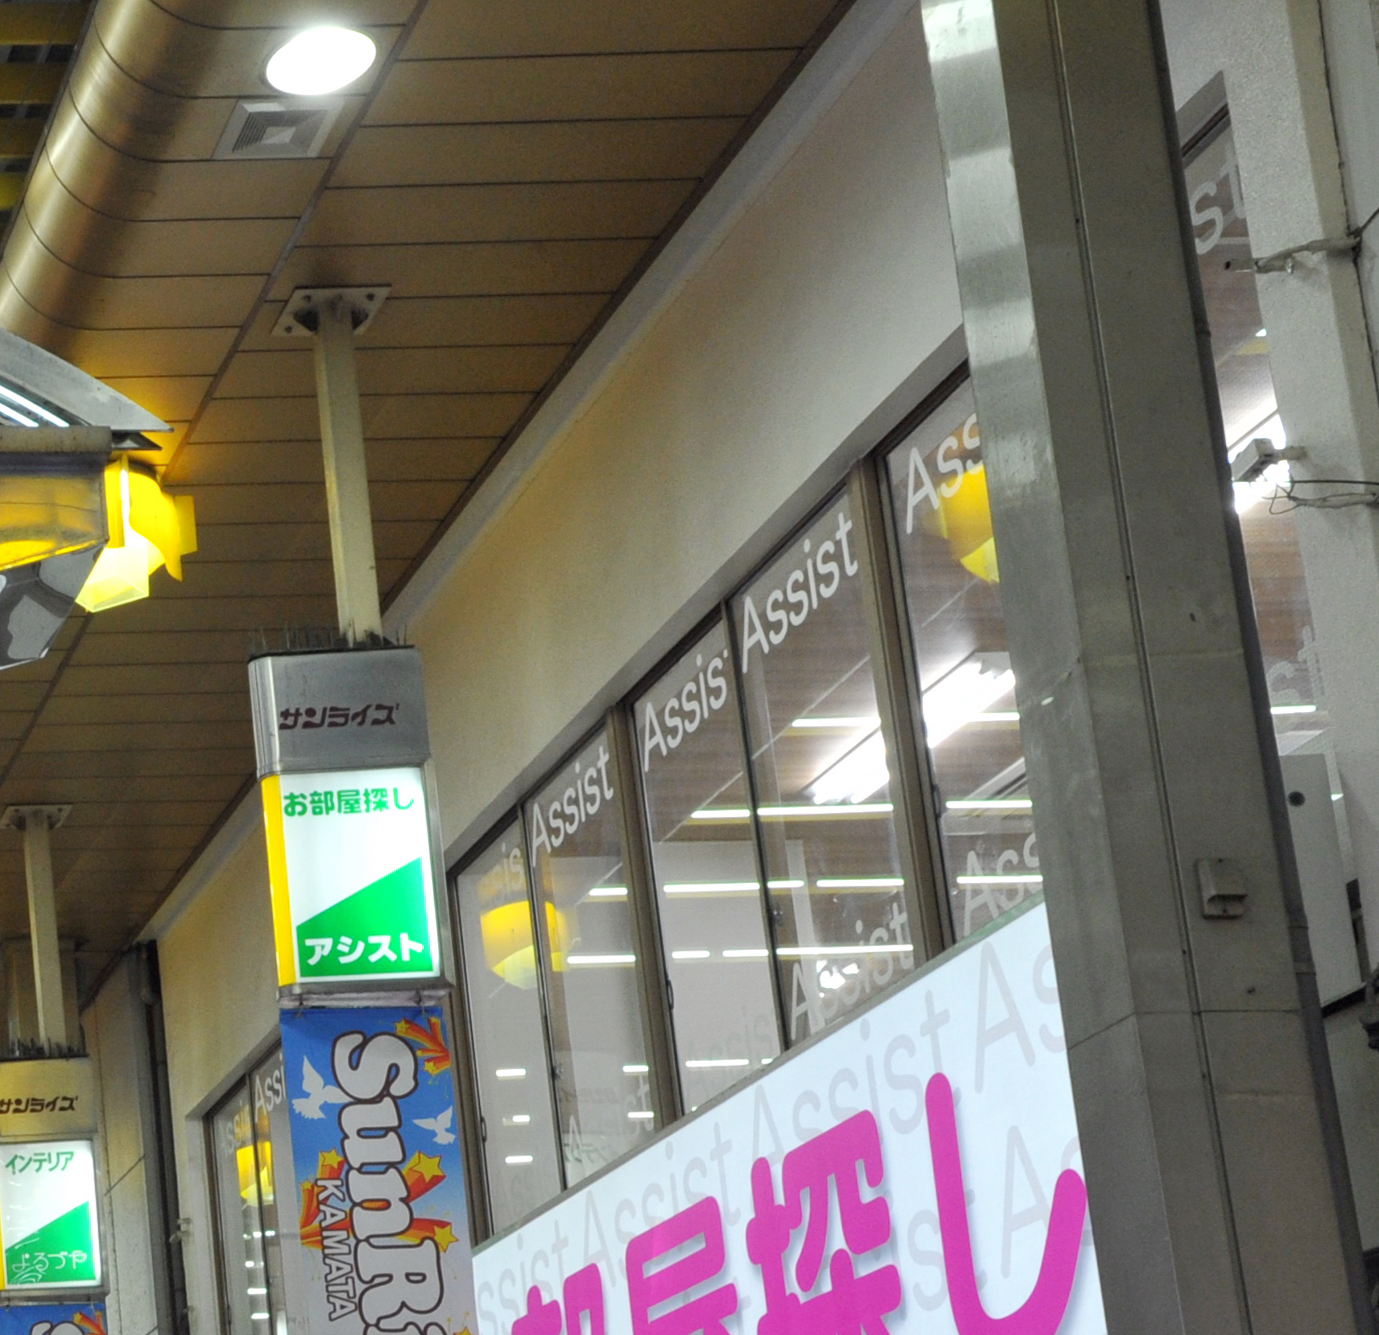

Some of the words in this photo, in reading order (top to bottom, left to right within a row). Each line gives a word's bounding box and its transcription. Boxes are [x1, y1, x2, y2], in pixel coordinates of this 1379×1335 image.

[741, 511, 859, 674] Assist
[279, 702, 401, 731] サンライズ
[643, 648, 729, 773] Assis
[282, 786, 415, 817] お部屋探し
[531, 745, 615, 868] Assist
[304, 932, 425, 967] アシスト
[5, 1151, 75, 1175] インテリア
[316, 1178, 359, 1322] KAMATA
